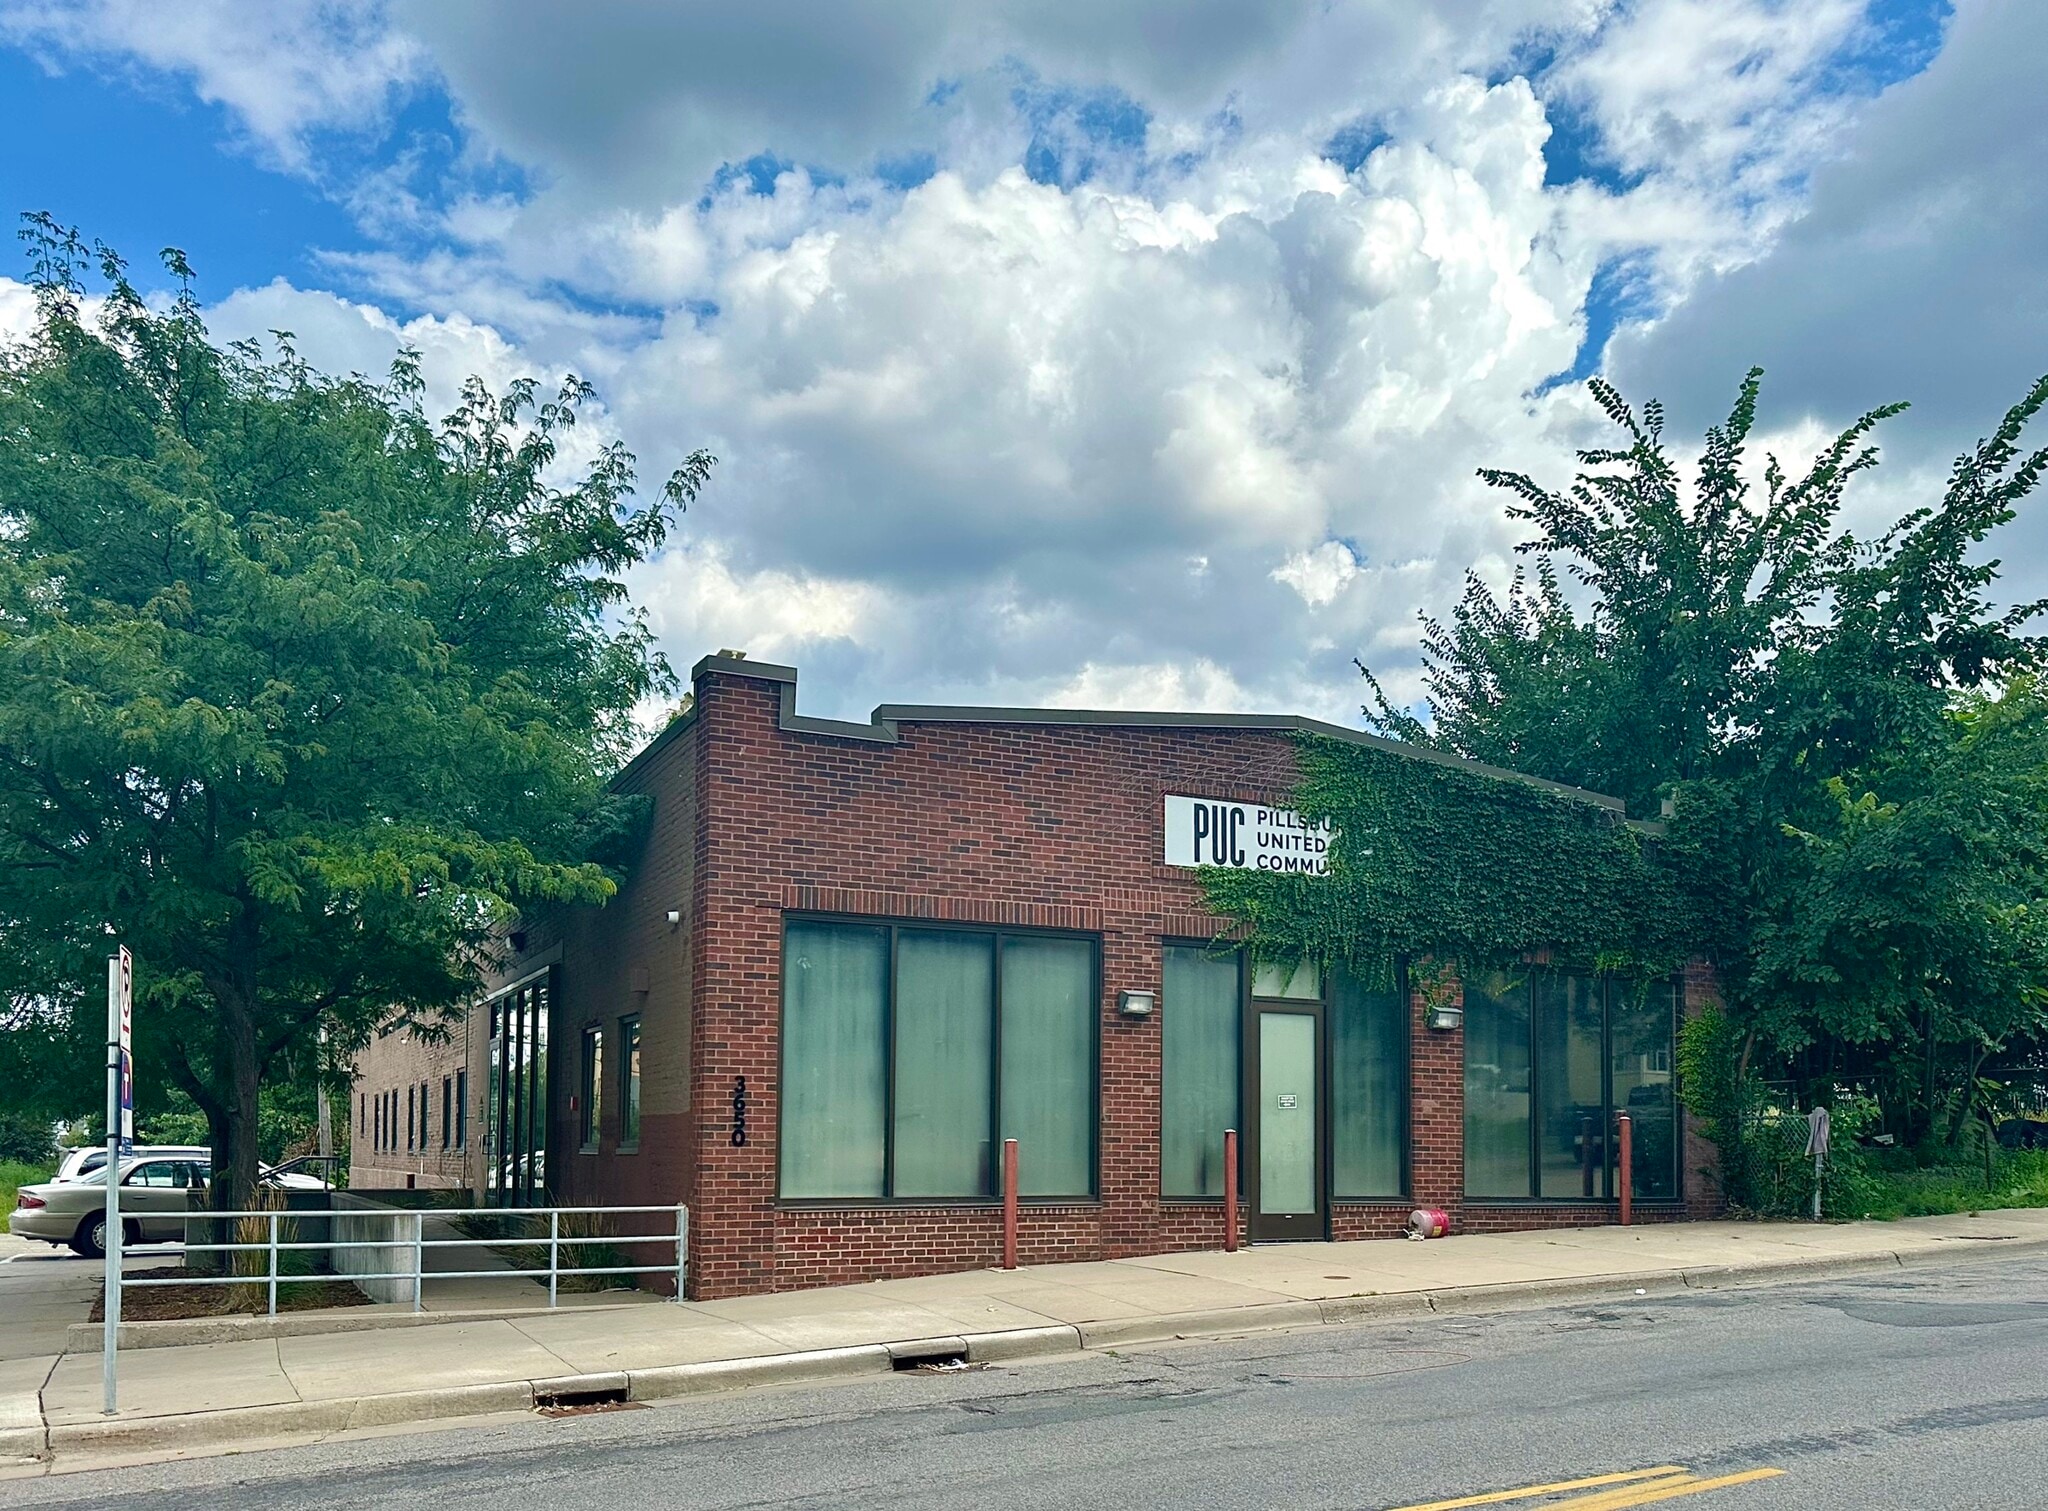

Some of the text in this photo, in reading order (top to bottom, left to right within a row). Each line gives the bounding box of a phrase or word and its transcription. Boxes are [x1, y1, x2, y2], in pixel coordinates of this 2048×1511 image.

[1194, 803, 1245, 866] PUC
[1257, 832, 1326, 853] UNITED
[1257, 854, 1333, 875] COMMU
[731, 1075, 746, 1147] 3650
